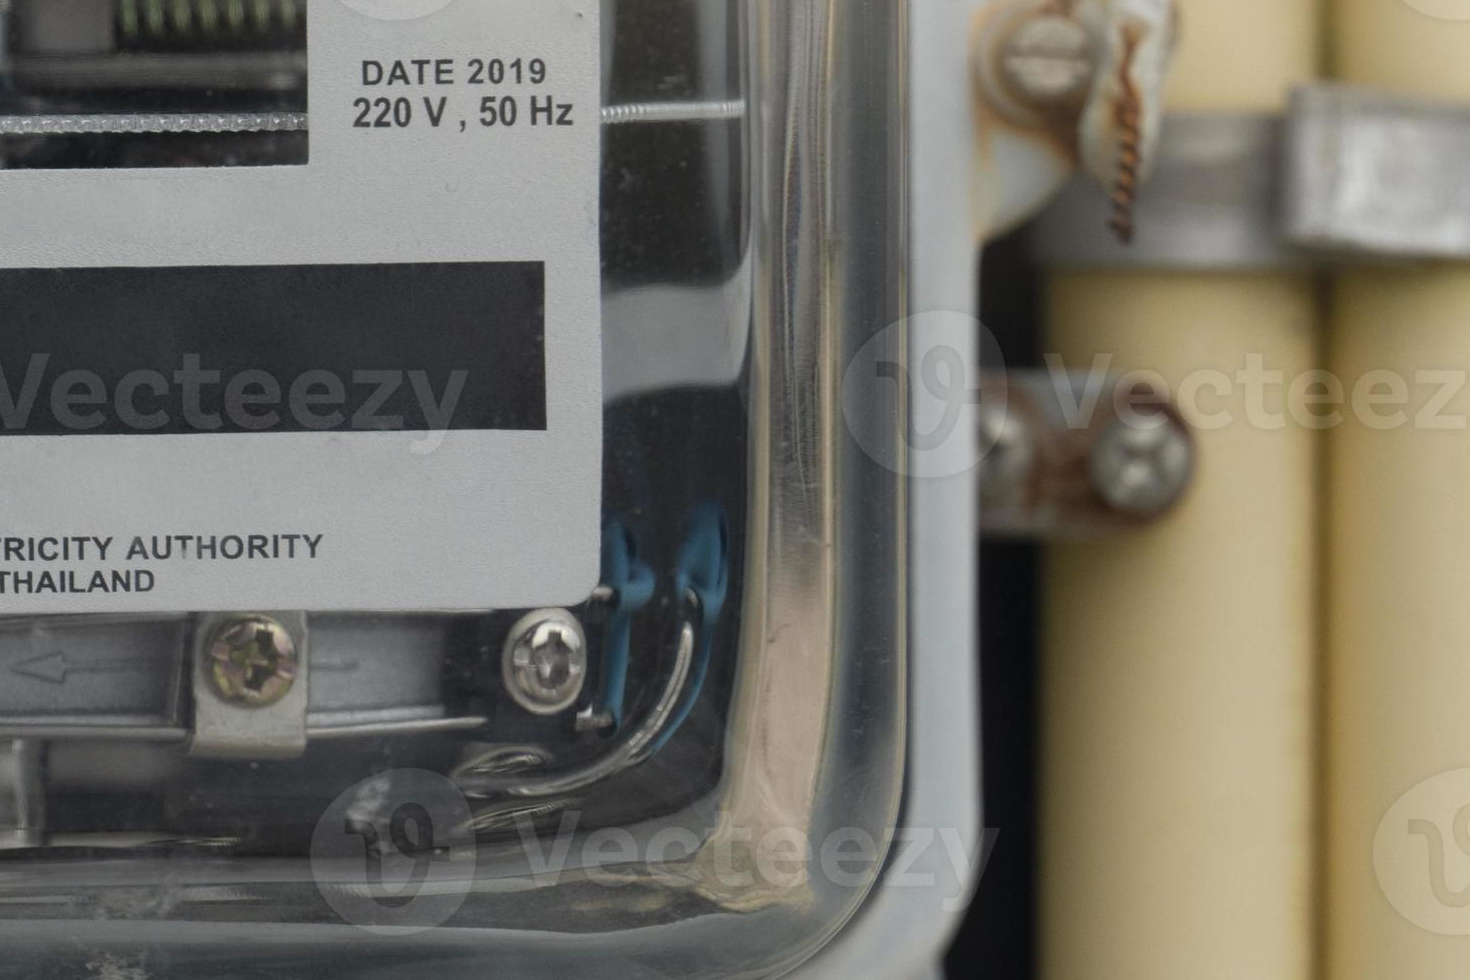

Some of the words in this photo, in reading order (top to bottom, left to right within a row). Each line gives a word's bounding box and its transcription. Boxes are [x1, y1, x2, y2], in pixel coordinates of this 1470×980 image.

[362, 59, 454, 85] DATE
[467, 58, 546, 84] 2019
[352, 96, 412, 127] 220
[480, 95, 517, 126] 50
[530, 95, 574, 125] Hz
[126, 534, 324, 560] AUTHORITY
